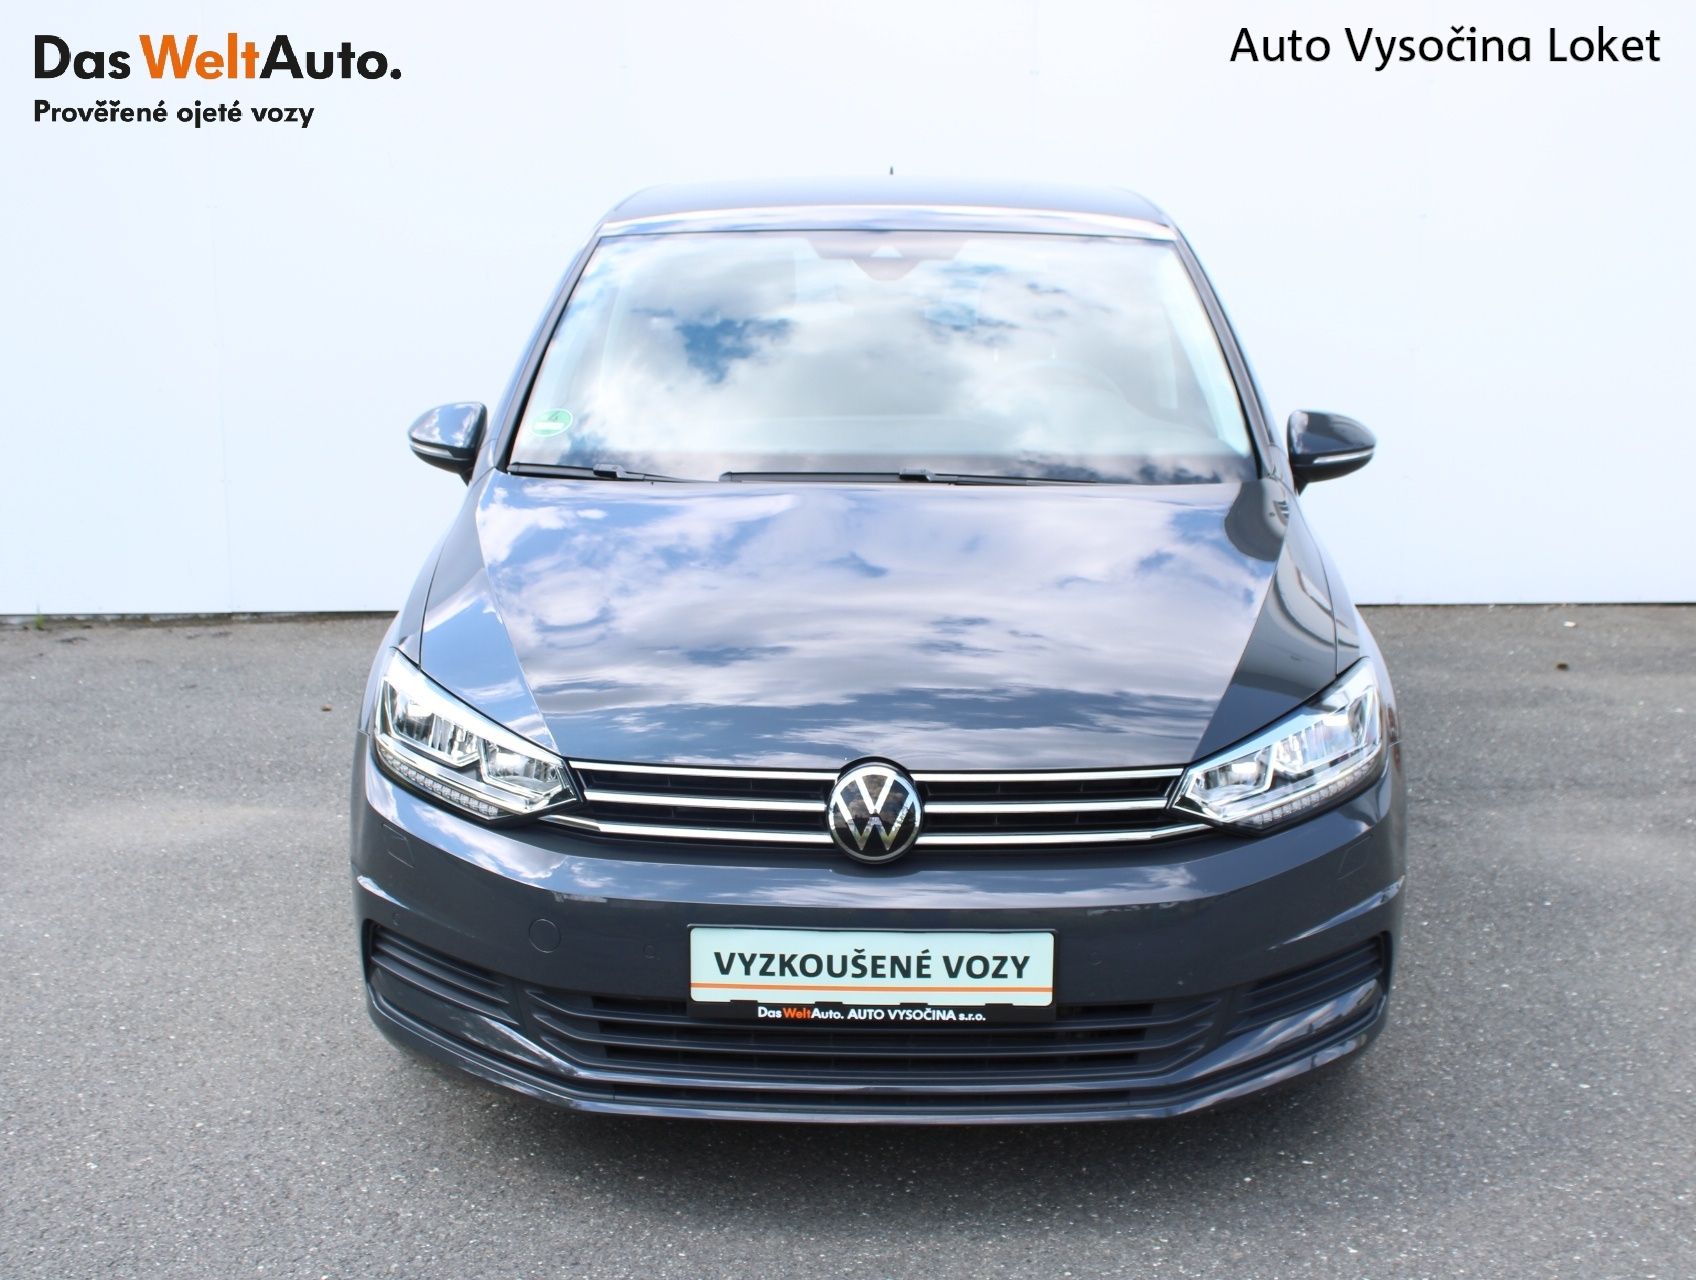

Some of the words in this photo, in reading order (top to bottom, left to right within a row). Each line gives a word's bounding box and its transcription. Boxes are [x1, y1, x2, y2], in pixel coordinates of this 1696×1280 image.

[714, 948, 932, 979] VYZKOUŠENÉ
[943, 955, 1031, 979] VOZY
[757, 1006, 782, 1019] Das
[783, 1006, 844, 1020] WeltAuto.
[847, 1008, 885, 1020] AUTO
[887, 1006, 956, 1021] VYSOČINA
[958, 1011, 986, 1021] s.r.o.
